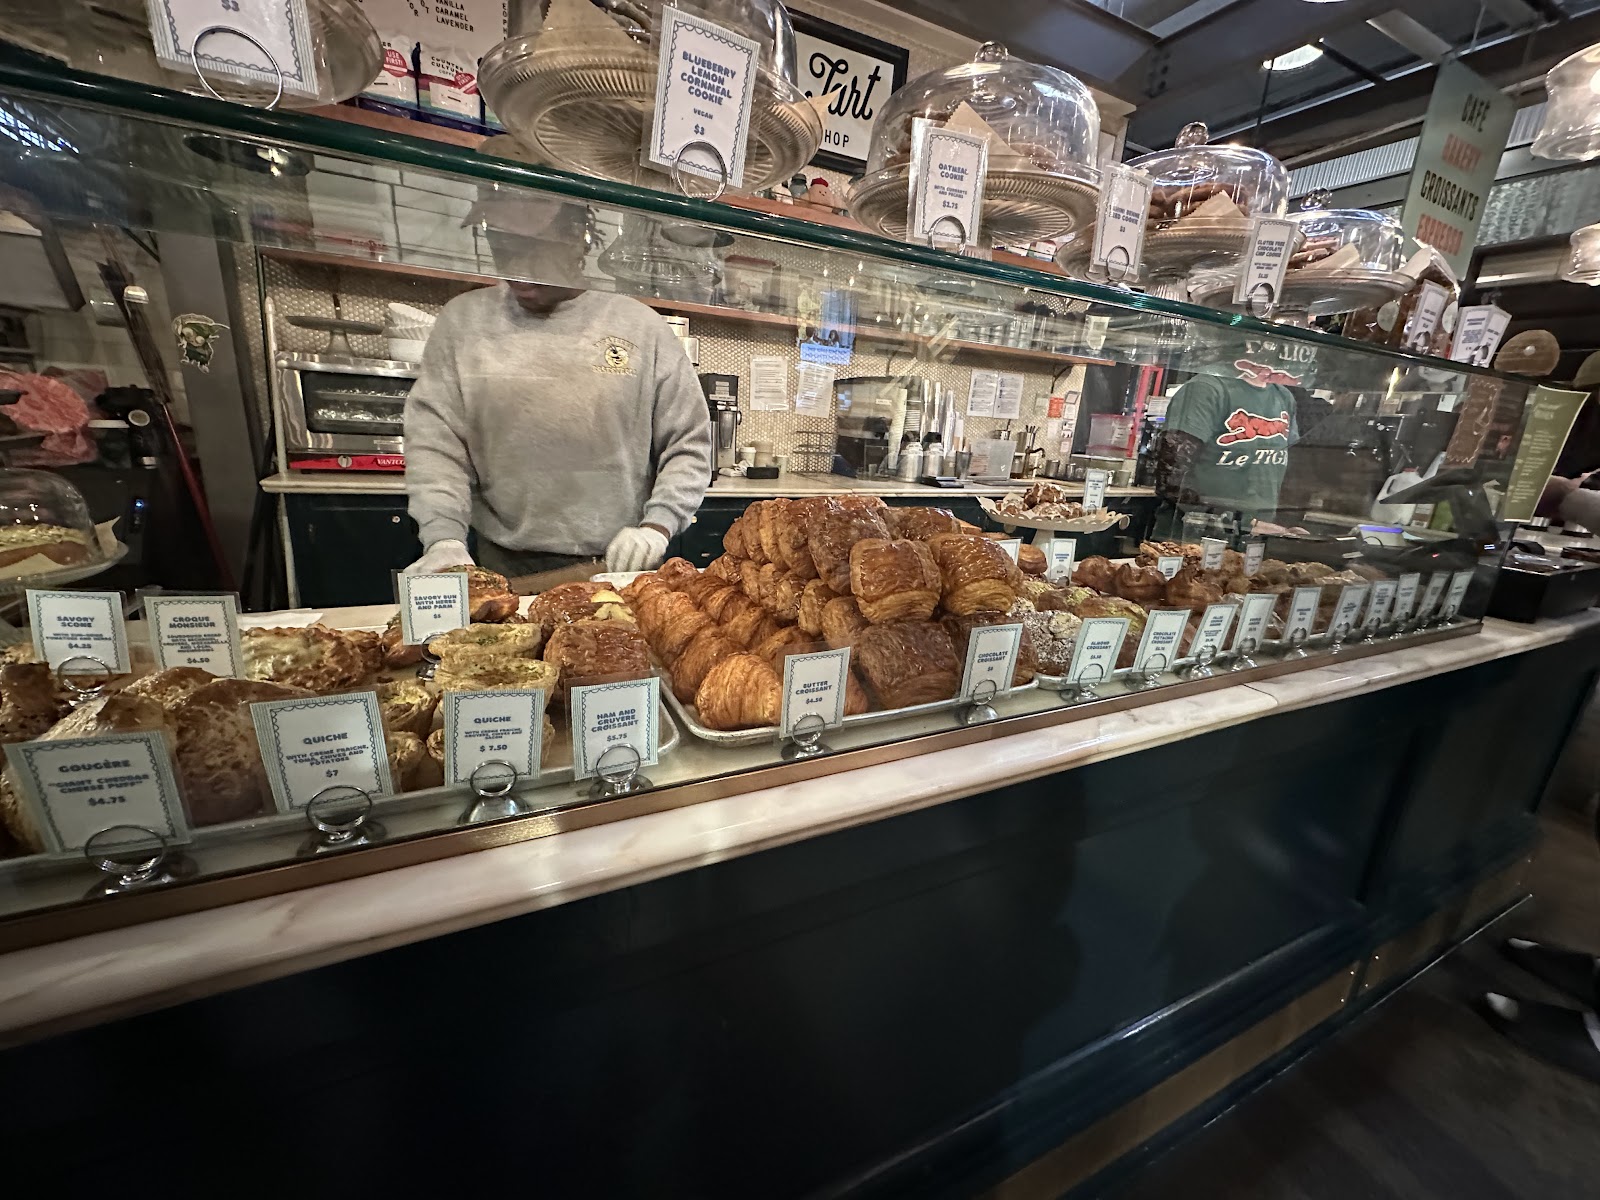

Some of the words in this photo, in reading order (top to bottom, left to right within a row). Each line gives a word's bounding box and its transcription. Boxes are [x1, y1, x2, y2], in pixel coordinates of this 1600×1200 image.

[435, 6, 469, 22] CARAMEL
[436, 15, 474, 32] LAVENDER
[387, 51, 400, 60] USE
[431, 56, 464, 72] COUNTER
[682, 50, 736, 79] BLUEBERRY
[691, 65, 725, 85] LEMON
[681, 72, 732, 99] CORNMEAL
[805, 52, 881, 120] Tart
[688, 86, 724, 105] COOKIE
[693, 107, 713, 120] VEGAN
[694, 123, 705, 136] $3
[825, 129, 850, 148] HOP
[938, 163, 969, 175] OATMEAL
[940, 171, 964, 181] COOKIE
[1420, 170, 1479, 221] CROISSANTS
[1216, 450, 1249, 466] Le
[978, 651, 1009, 659] CHOCOLATE
[795, 684, 833, 695] CROISSANT
[803, 680, 828, 689] BUTTER
[473, 716, 512, 724] QUICHE
[596, 711, 617, 720] HAM
[618, 708, 636, 716] AND
[597, 714, 636, 725] GRUYERE
[591, 719, 639, 733] CROISSANT
[302, 732, 348, 745] QUICHE
[606, 733, 628, 742] $5.75
[286, 753, 307, 761] WITH
[309, 749, 334, 757] CREME
[319, 752, 347, 761] CHIVES
[310, 756, 350, 767] POTATOES
[97, 774, 150, 784] CHEDDAR
[326, 769, 339, 778] $7
[60, 784, 105, 794] CHEESE
[88, 796, 126, 807] $4.75
